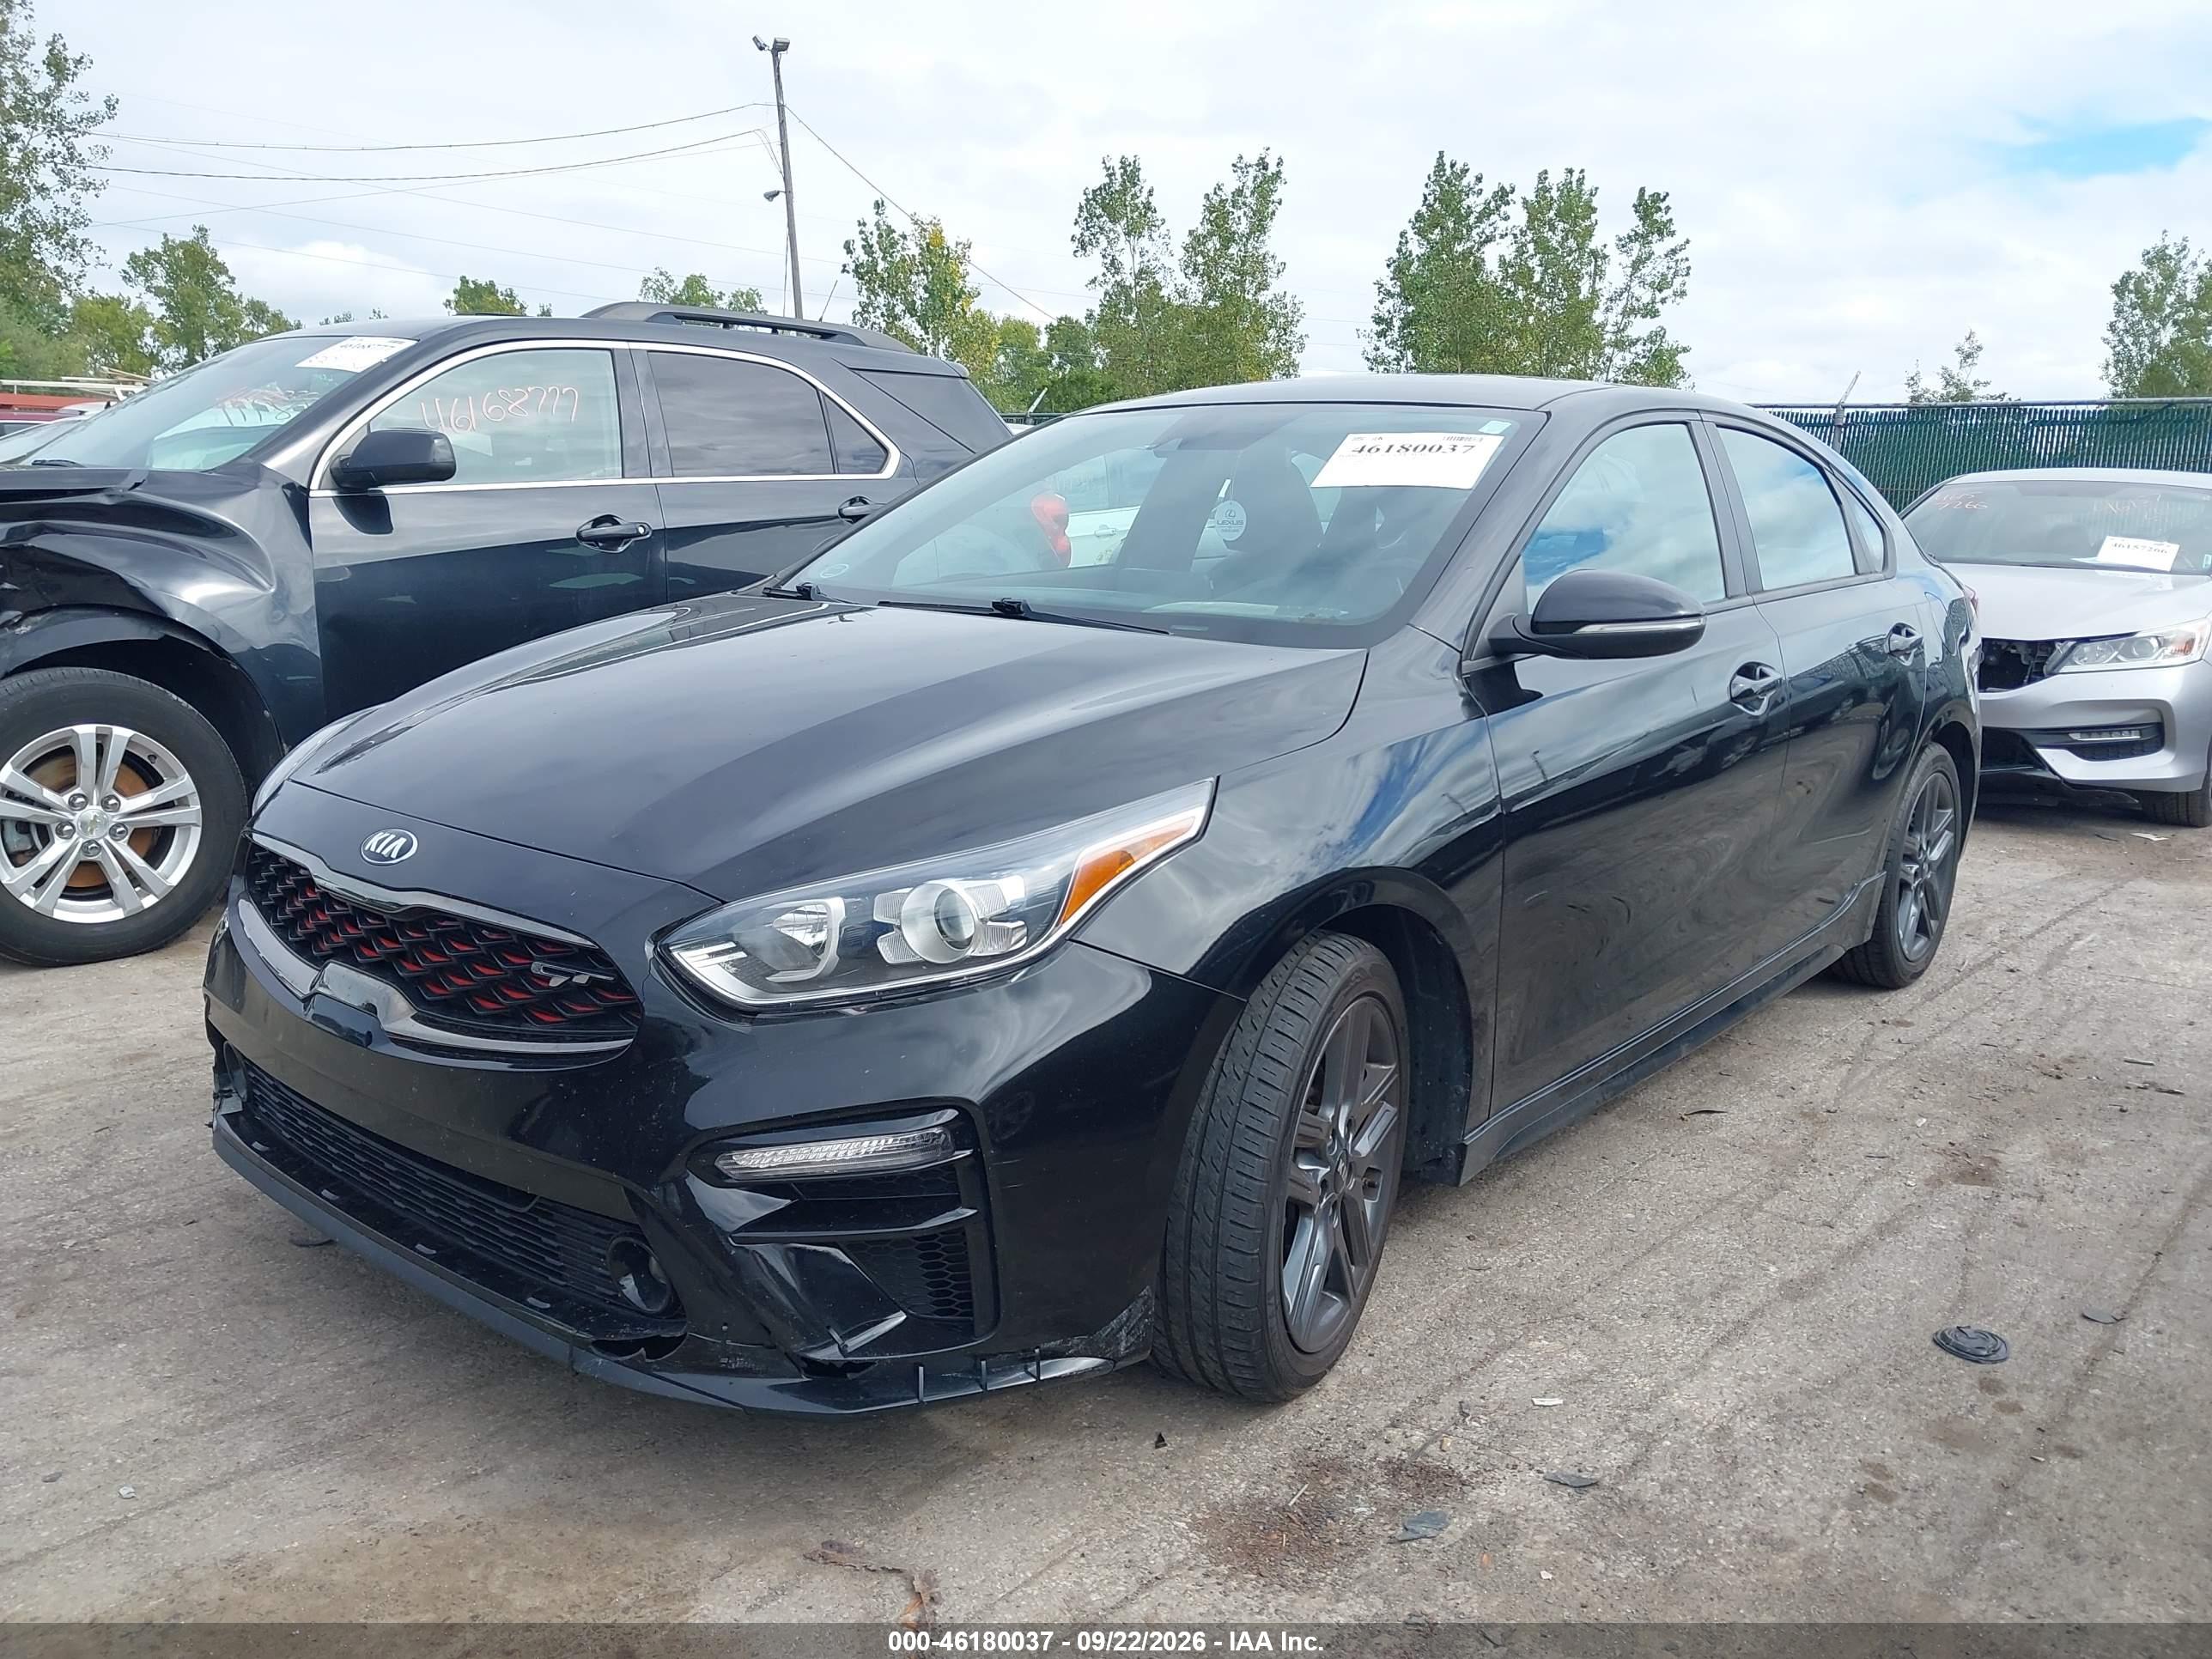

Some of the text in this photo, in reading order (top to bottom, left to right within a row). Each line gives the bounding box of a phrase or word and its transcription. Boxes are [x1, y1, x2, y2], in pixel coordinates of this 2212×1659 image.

[420, 386, 579, 434] 46168777
[1351, 443, 1477, 455] 46180037
[364, 831, 408, 860] KIA
